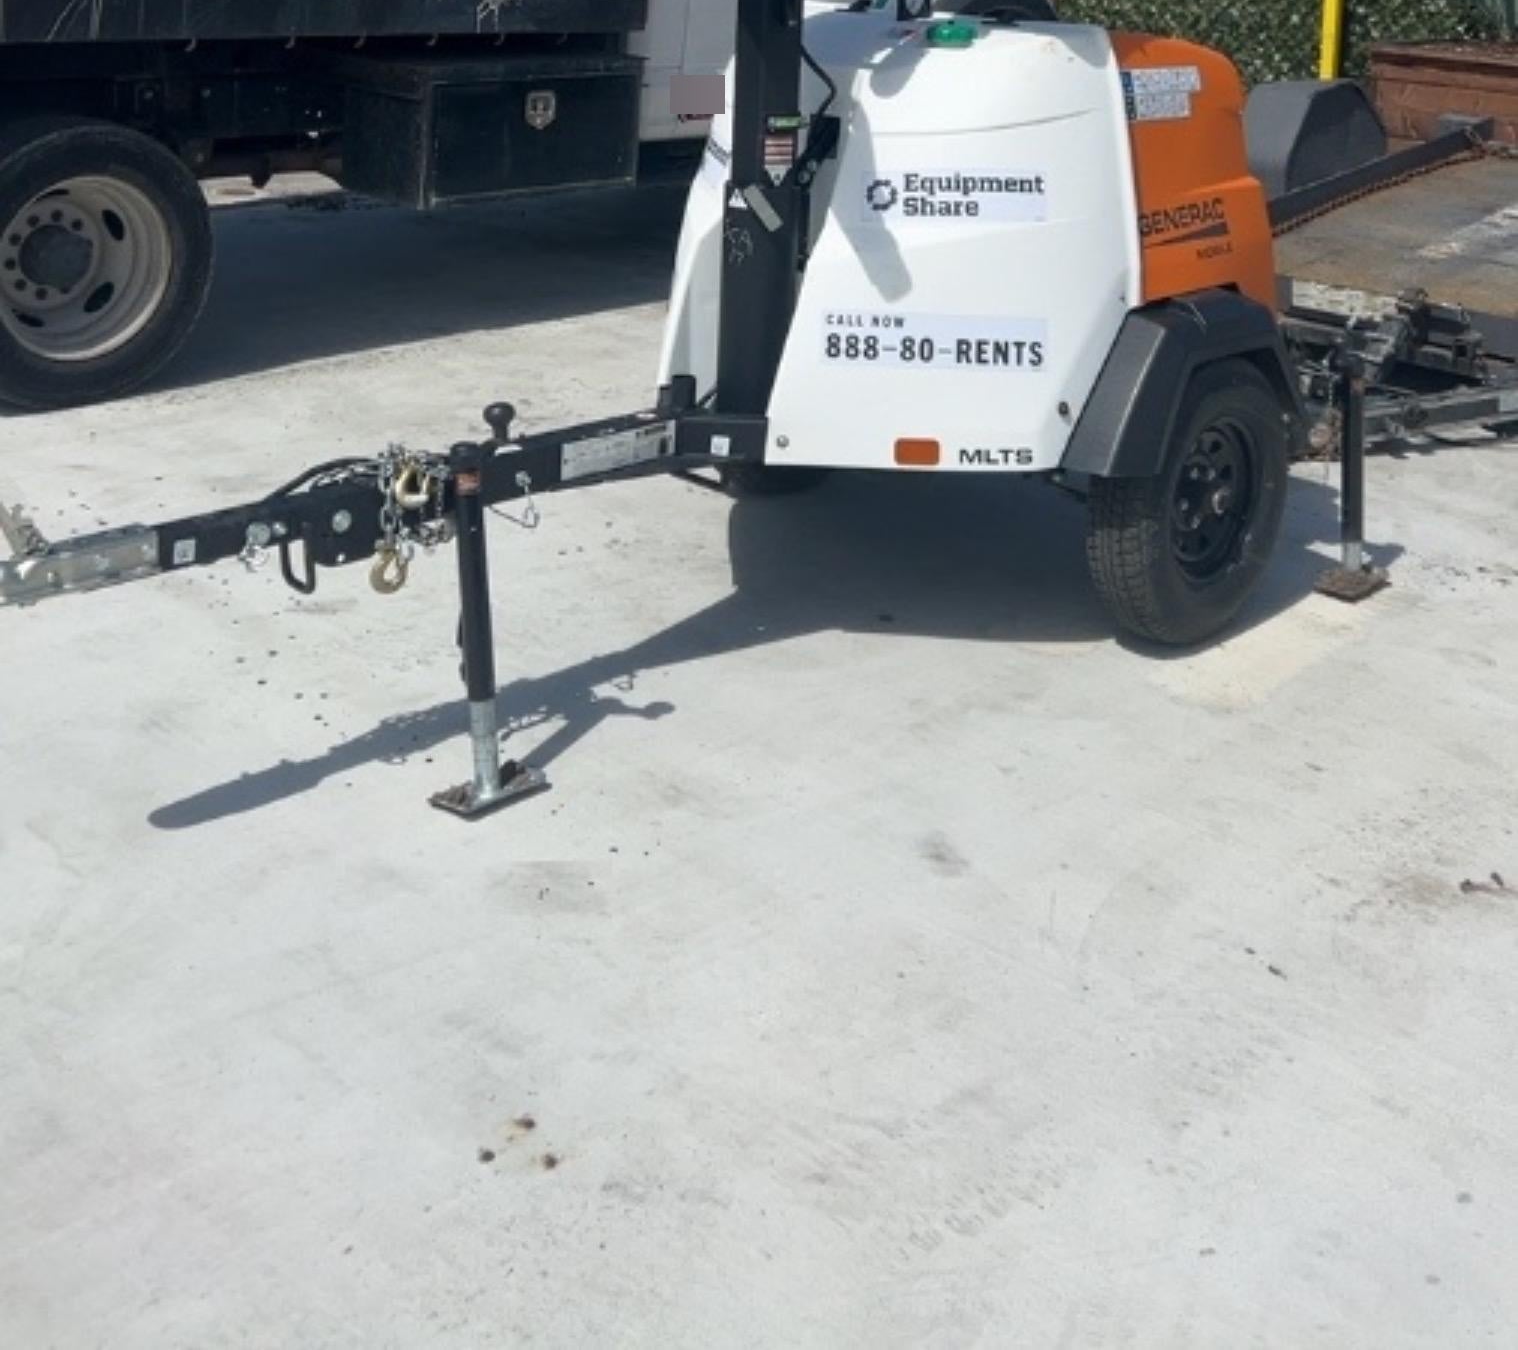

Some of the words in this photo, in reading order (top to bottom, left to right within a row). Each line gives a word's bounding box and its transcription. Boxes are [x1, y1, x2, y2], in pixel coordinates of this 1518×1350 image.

[903, 172, 1045, 196] Equipment
[903, 197, 979, 217] Share
[825, 314, 864, 327] CALL
[870, 315, 905, 328] NOW
[825, 332, 1044, 367] 888-80-RENTS
[959, 448, 1033, 465] MLTS
